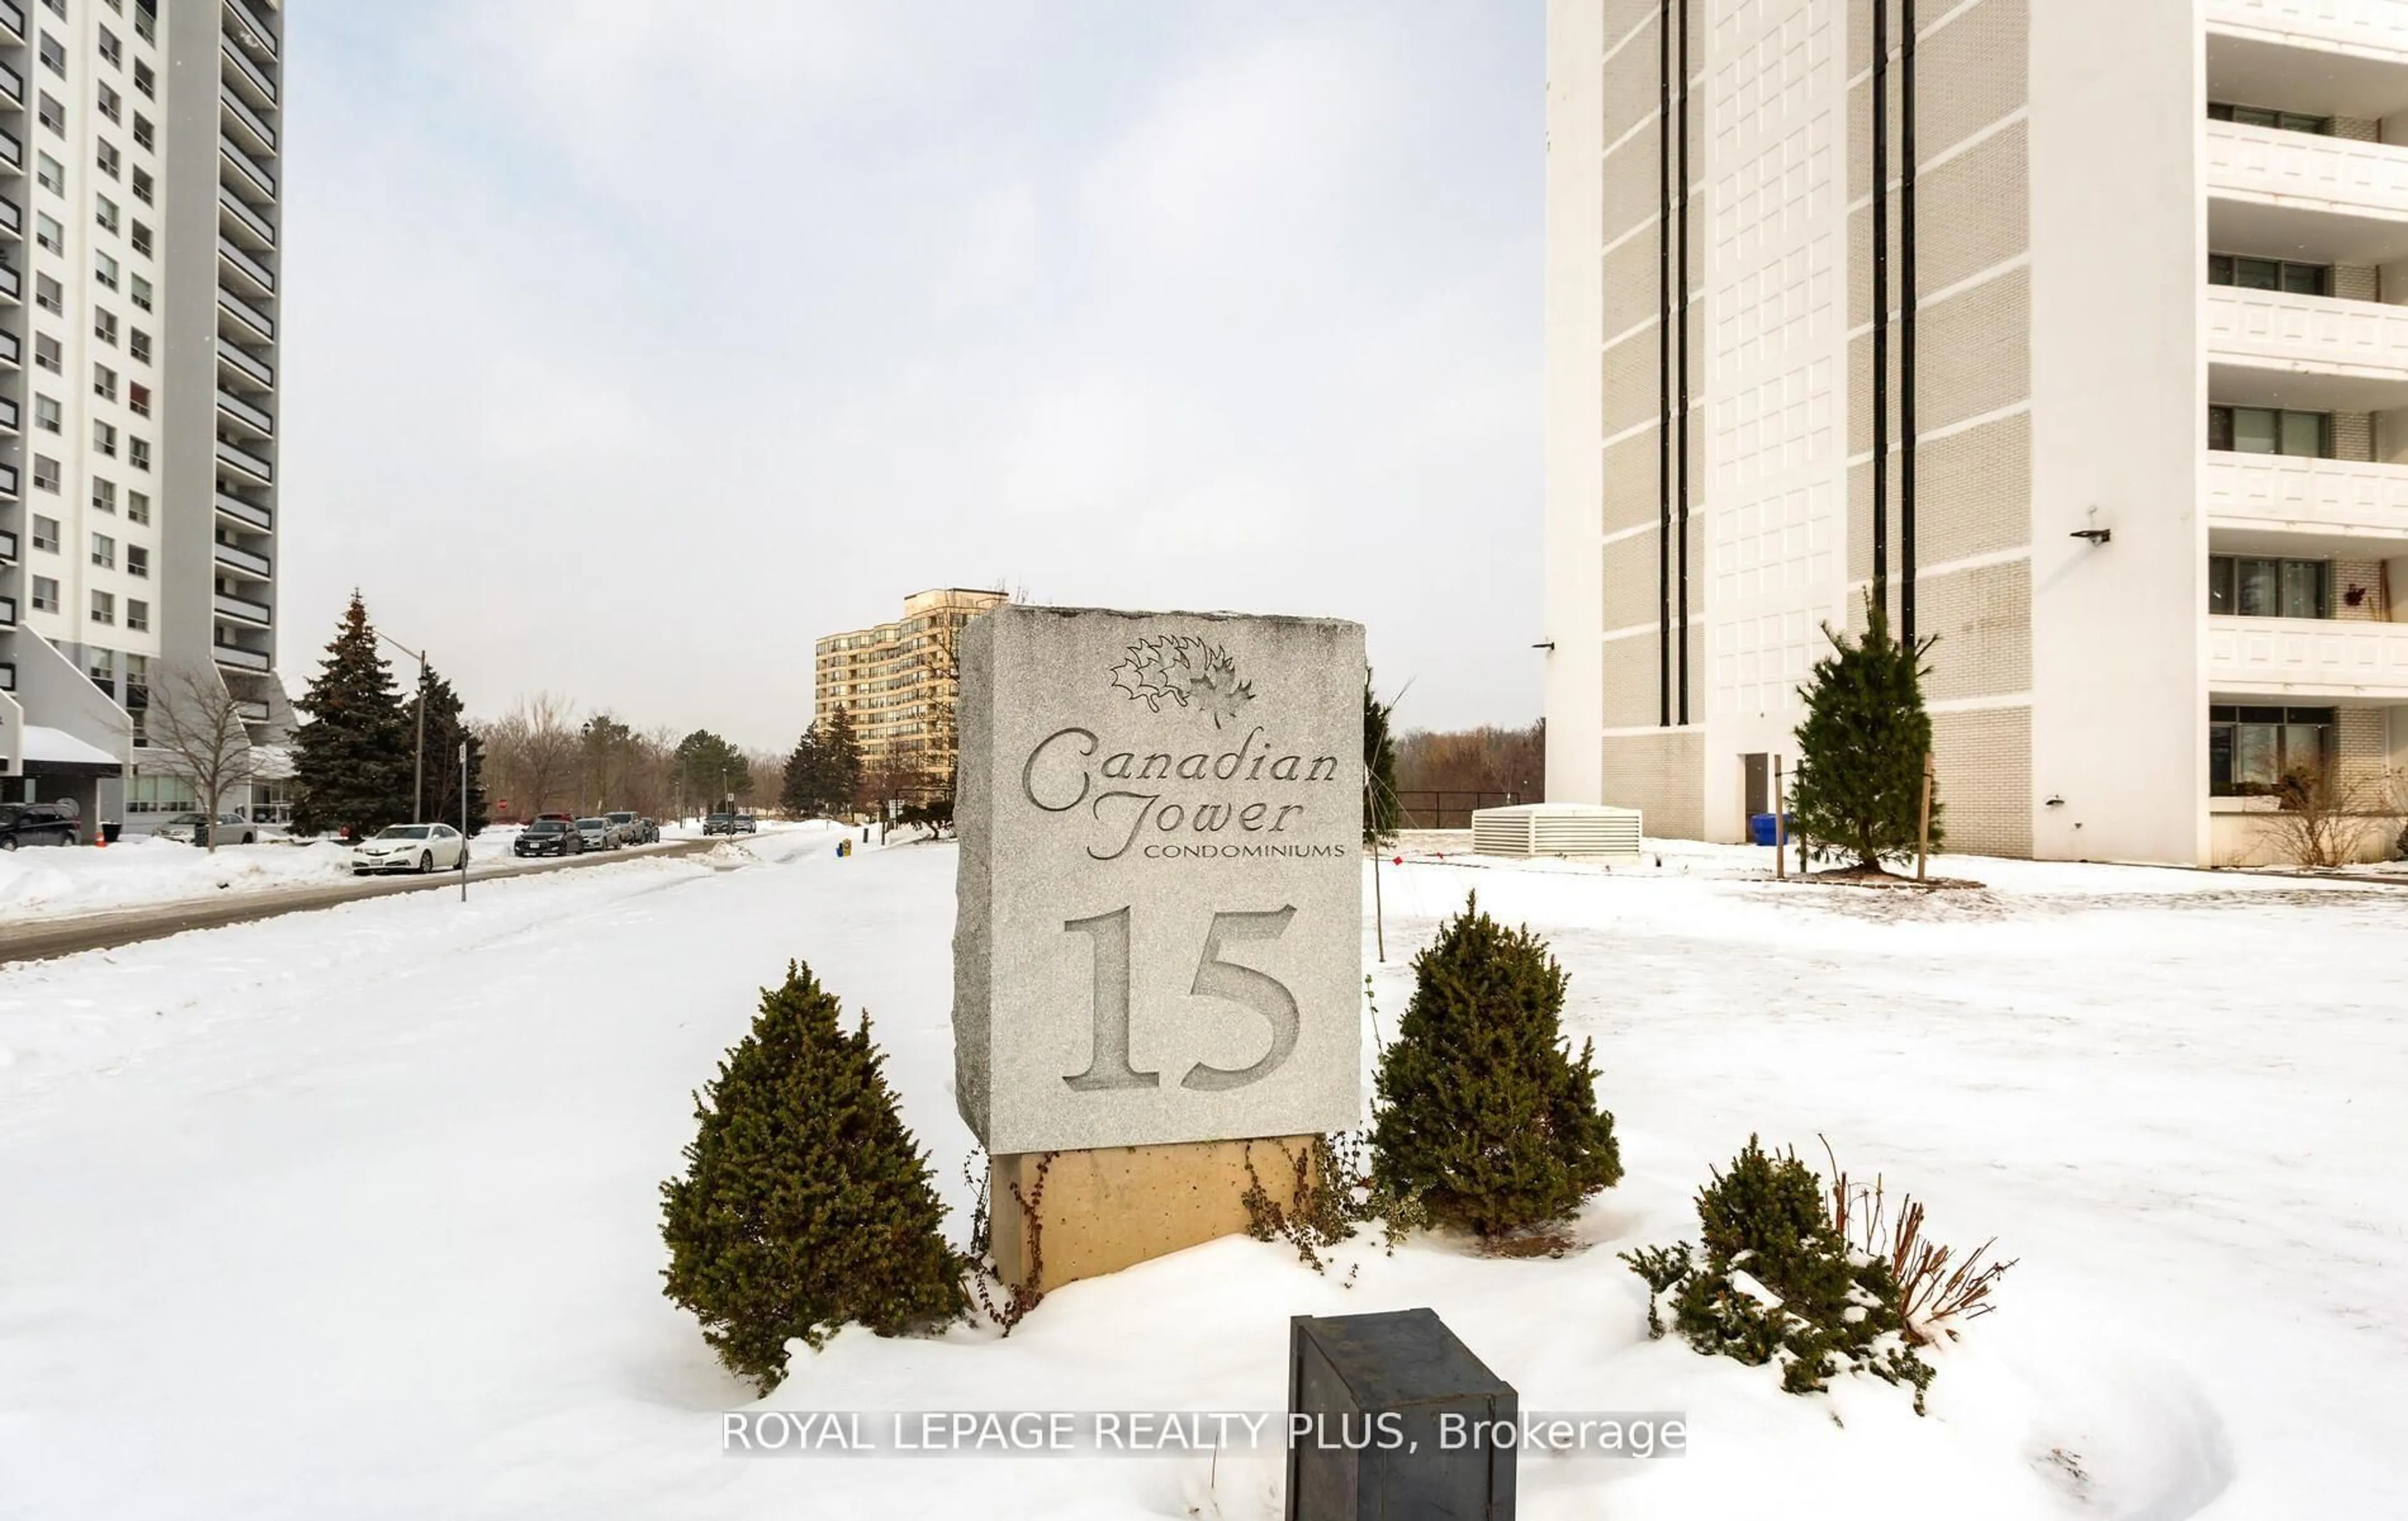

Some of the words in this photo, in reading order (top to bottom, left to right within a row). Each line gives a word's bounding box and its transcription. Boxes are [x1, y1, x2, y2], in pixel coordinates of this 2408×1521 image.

[1022, 726, 1339, 812] Canadian
[1087, 790, 1304, 861] Tower
[1144, 844, 1345, 859] CONDOMINIUMS
[1062, 903, 1301, 1092] 15
